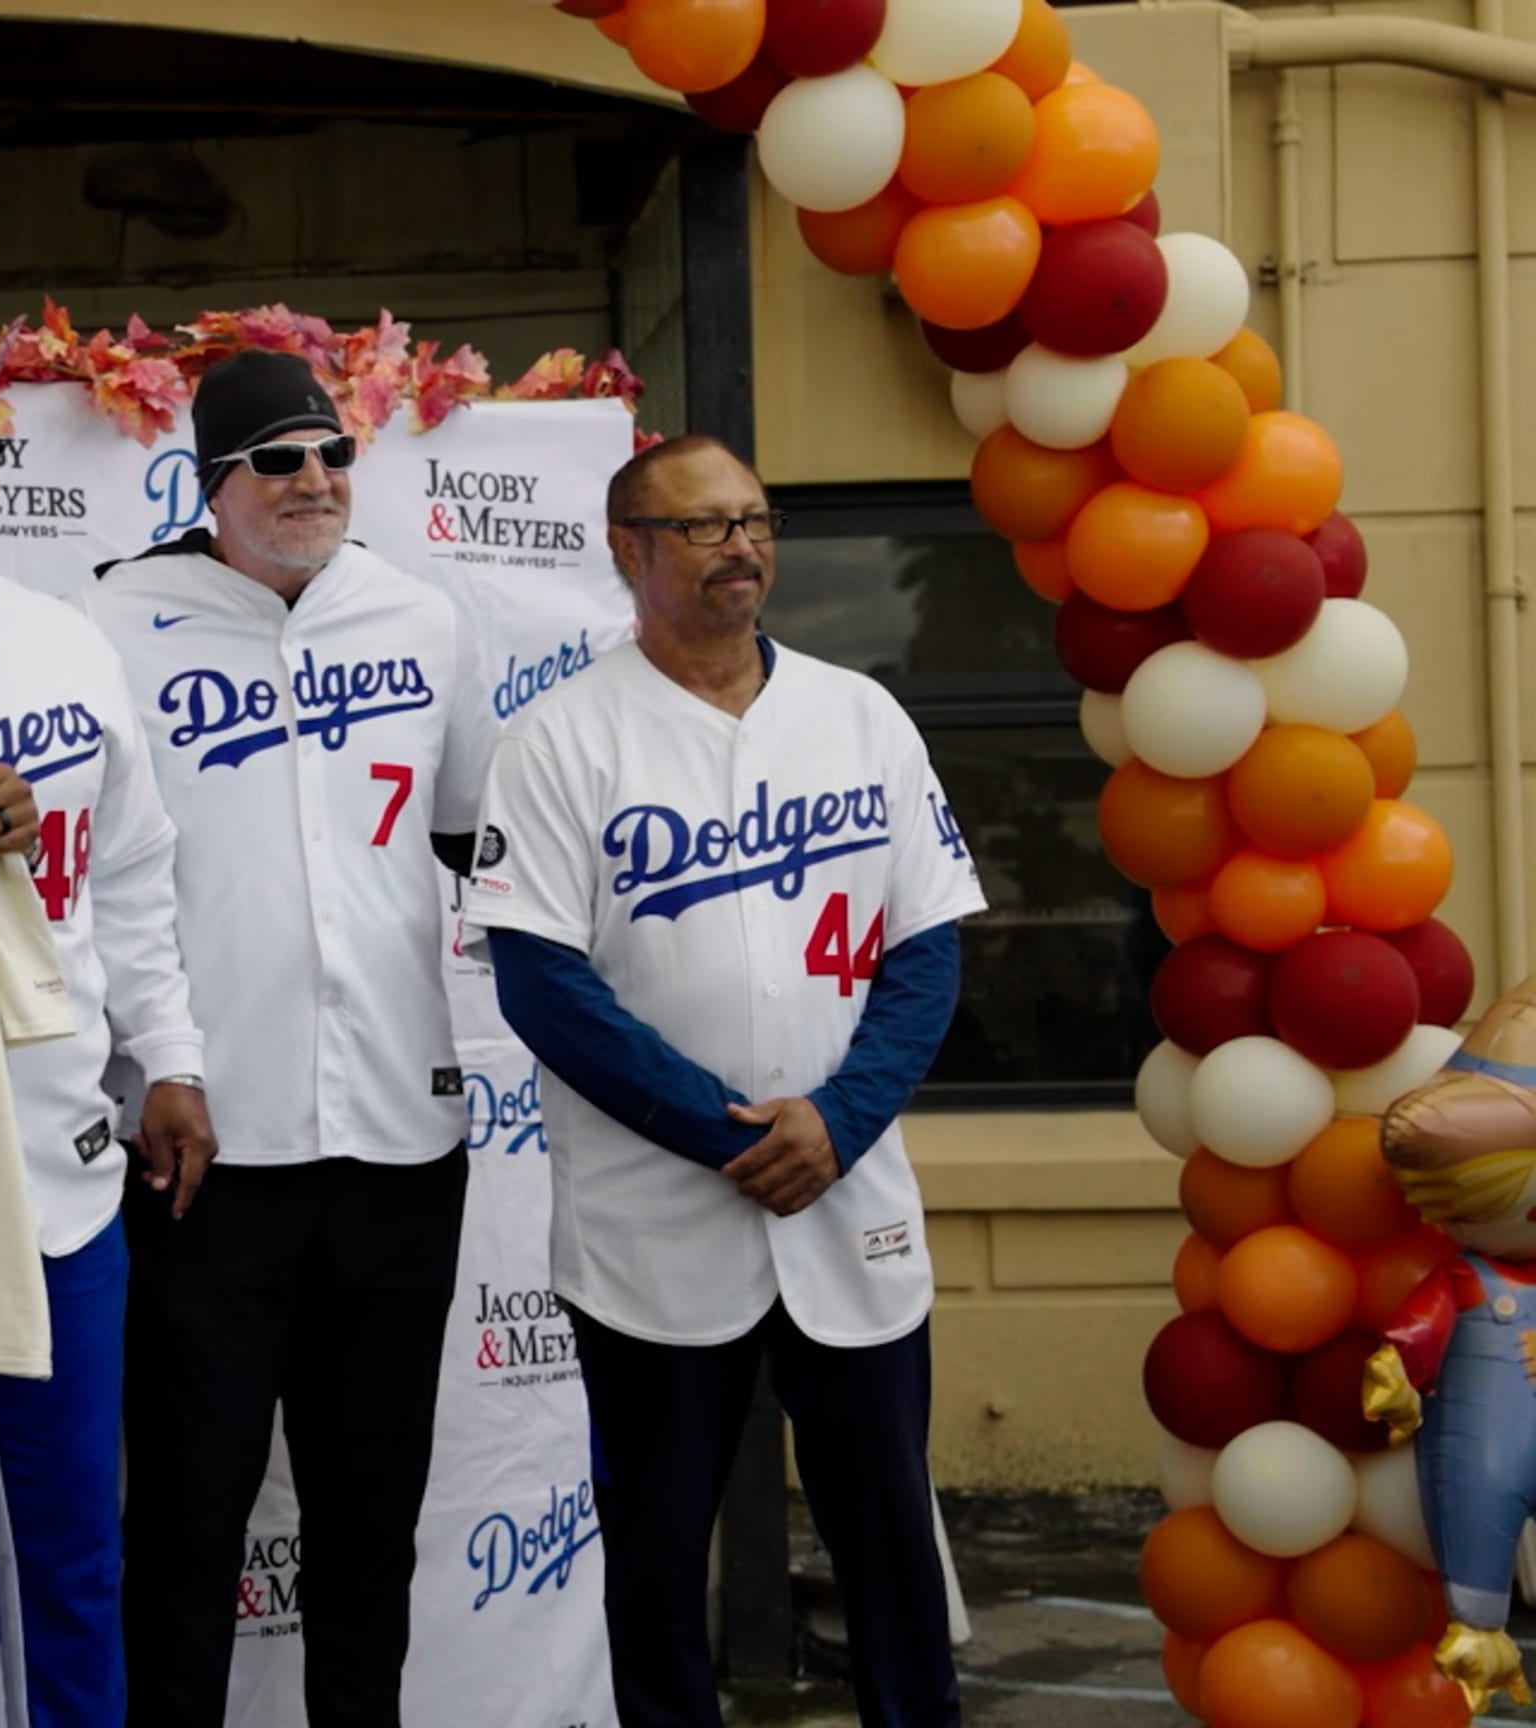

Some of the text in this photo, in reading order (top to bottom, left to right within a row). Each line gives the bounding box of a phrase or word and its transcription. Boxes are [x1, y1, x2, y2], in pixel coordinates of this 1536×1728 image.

[425, 458, 539, 504] JACOBY
[454, 551, 557, 569] INJURY LAWYERS
[158, 648, 434, 774] Dodgers
[370, 763, 414, 848] 7
[602, 780, 890, 923] Dodgers
[475, 1283, 562, 1323] JACOB
[467, 1480, 601, 1611] Dodge
